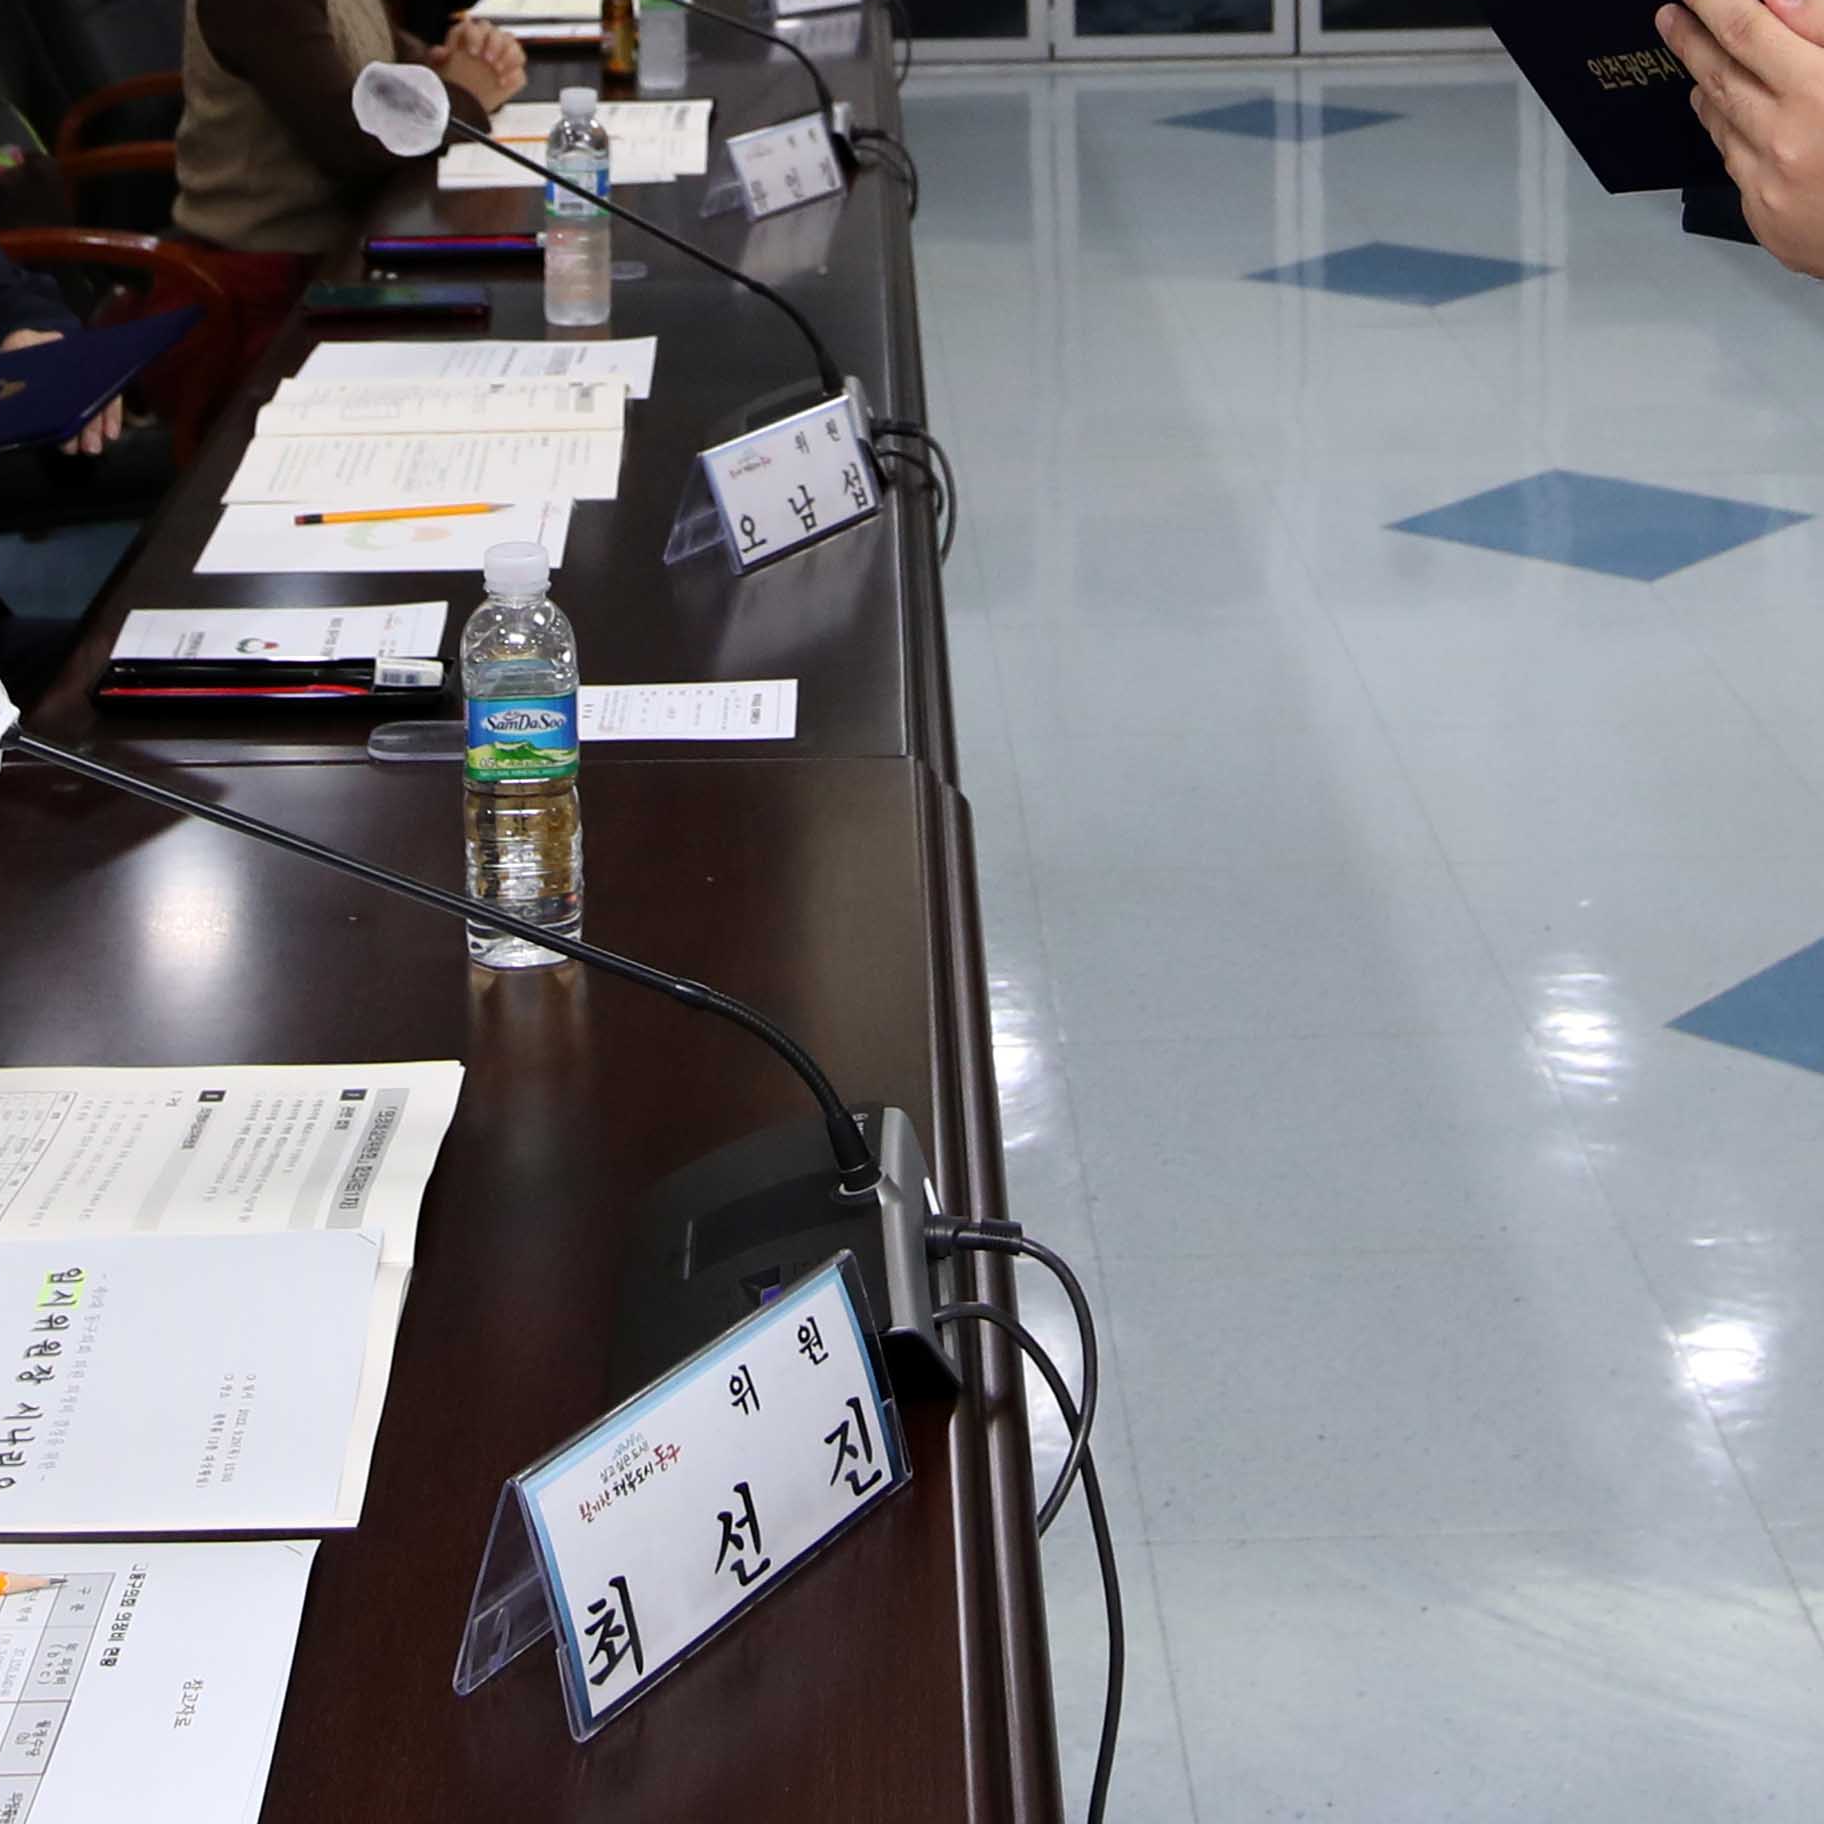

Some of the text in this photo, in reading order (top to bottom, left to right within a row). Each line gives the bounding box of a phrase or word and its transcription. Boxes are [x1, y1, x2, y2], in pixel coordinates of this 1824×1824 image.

[1586, 47, 1686, 90] 인천광역시
[794, 431, 810, 455] 위
[740, 462, 869, 555] 오 남 섭
[486, 713, 566, 732] SamDaSoo
[16, 1268, 85, 1385] 임시위원장
[728, 1315, 830, 1416] 위 원
[578, 1442, 682, 1524] 활기찬 행복도시 동구
[583, 1396, 884, 1687] 최 선 진
[99, 1572, 147, 1667] 동구의회 의정비 현황
[173, 1678, 204, 1729] 참고자료
